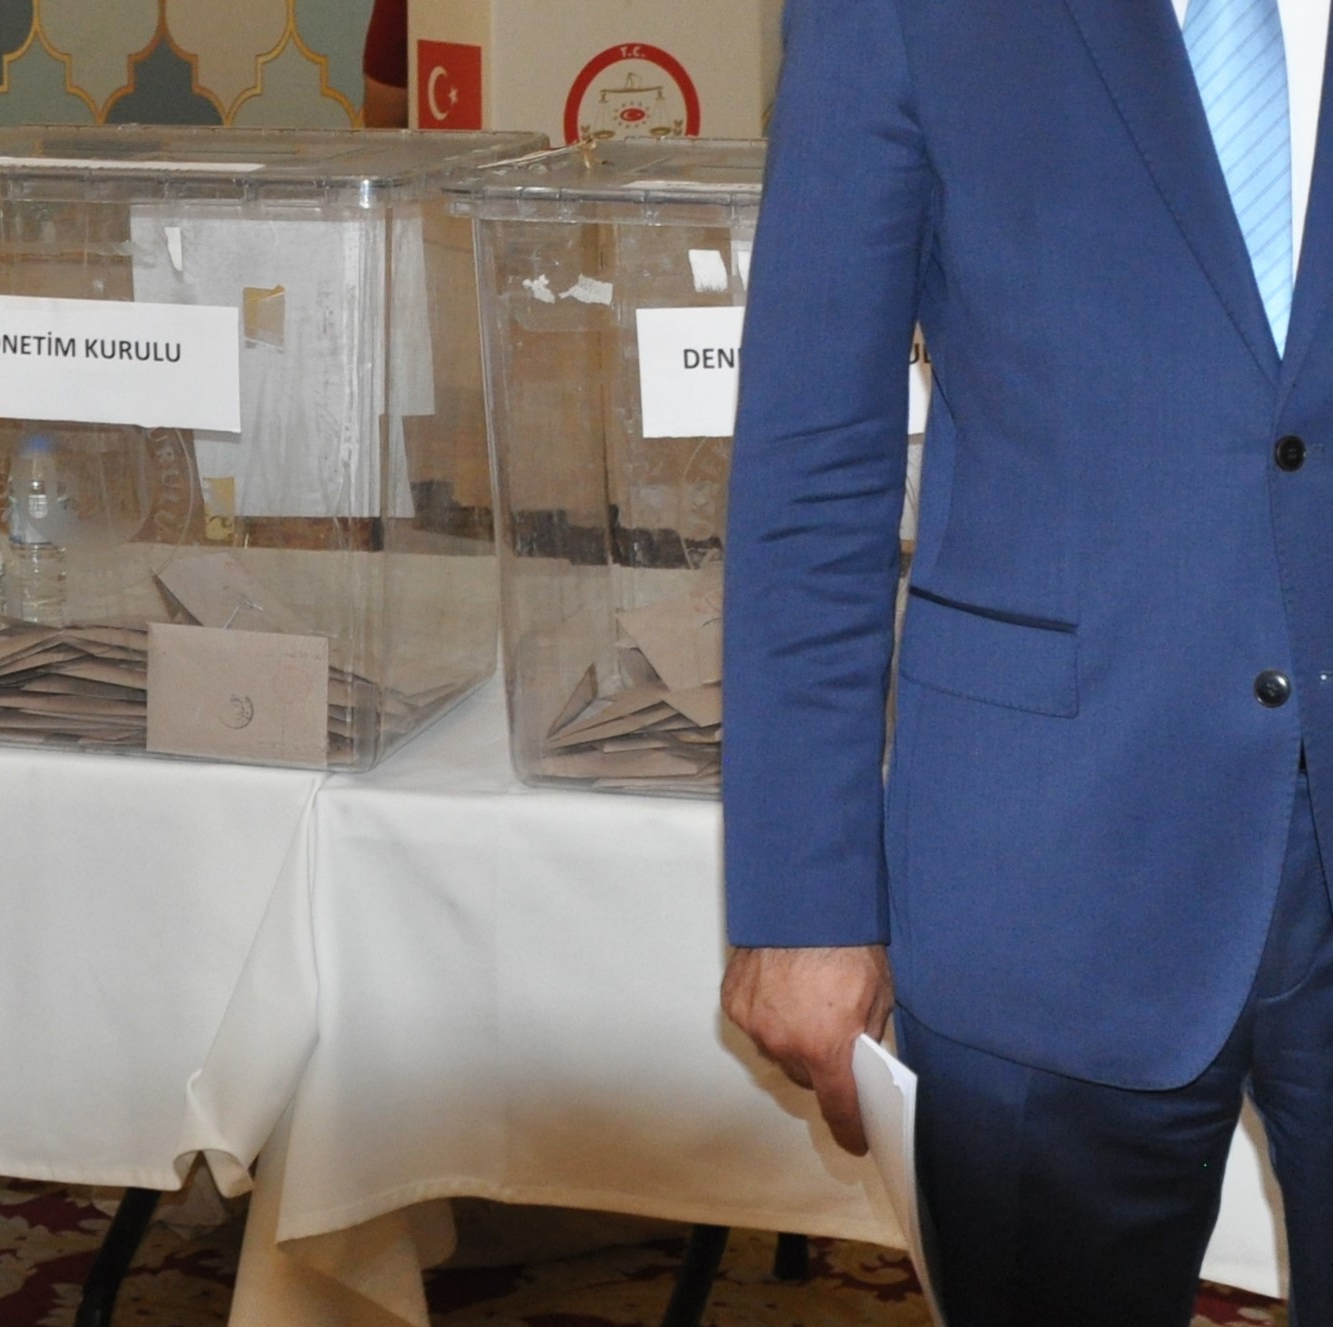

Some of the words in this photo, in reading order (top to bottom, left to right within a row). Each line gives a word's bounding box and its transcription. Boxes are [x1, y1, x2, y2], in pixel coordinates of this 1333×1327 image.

[619, 45, 647, 59] T.C.
[85, 338, 181, 363] KURULU
[683, 347, 740, 370] DEN
